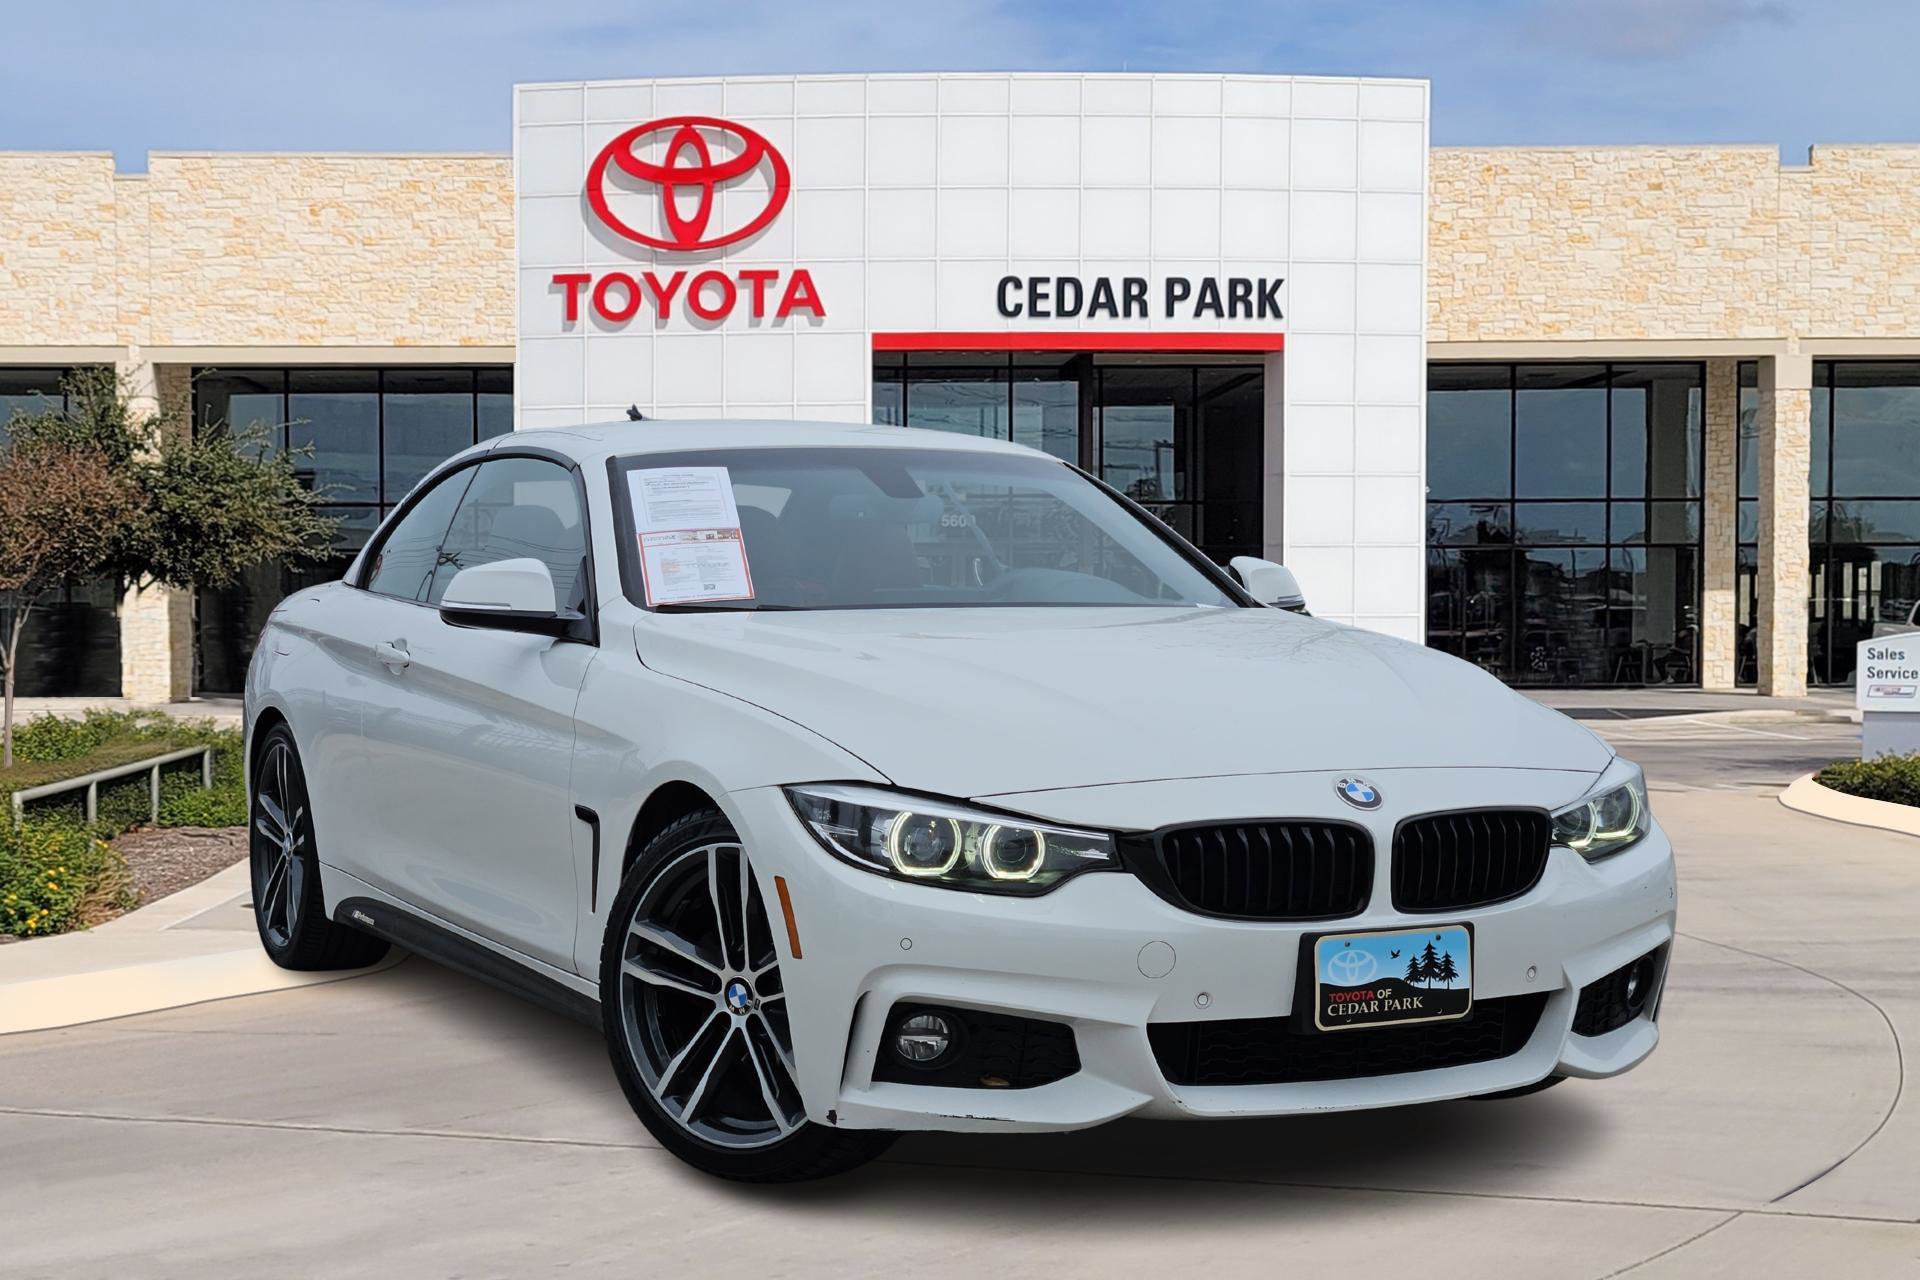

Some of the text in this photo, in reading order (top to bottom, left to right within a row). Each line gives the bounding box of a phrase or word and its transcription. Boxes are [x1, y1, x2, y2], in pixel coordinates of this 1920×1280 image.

[552, 268, 827, 323] TOYOTA
[996, 275, 1285, 319] CEDAR PARK
[1867, 647, 1906, 661] Sales
[1866, 666, 1919, 680] Service
[1328, 988, 1392, 1003] TOYOTA OF
[1327, 996, 1424, 1017] CEDAR PARK
